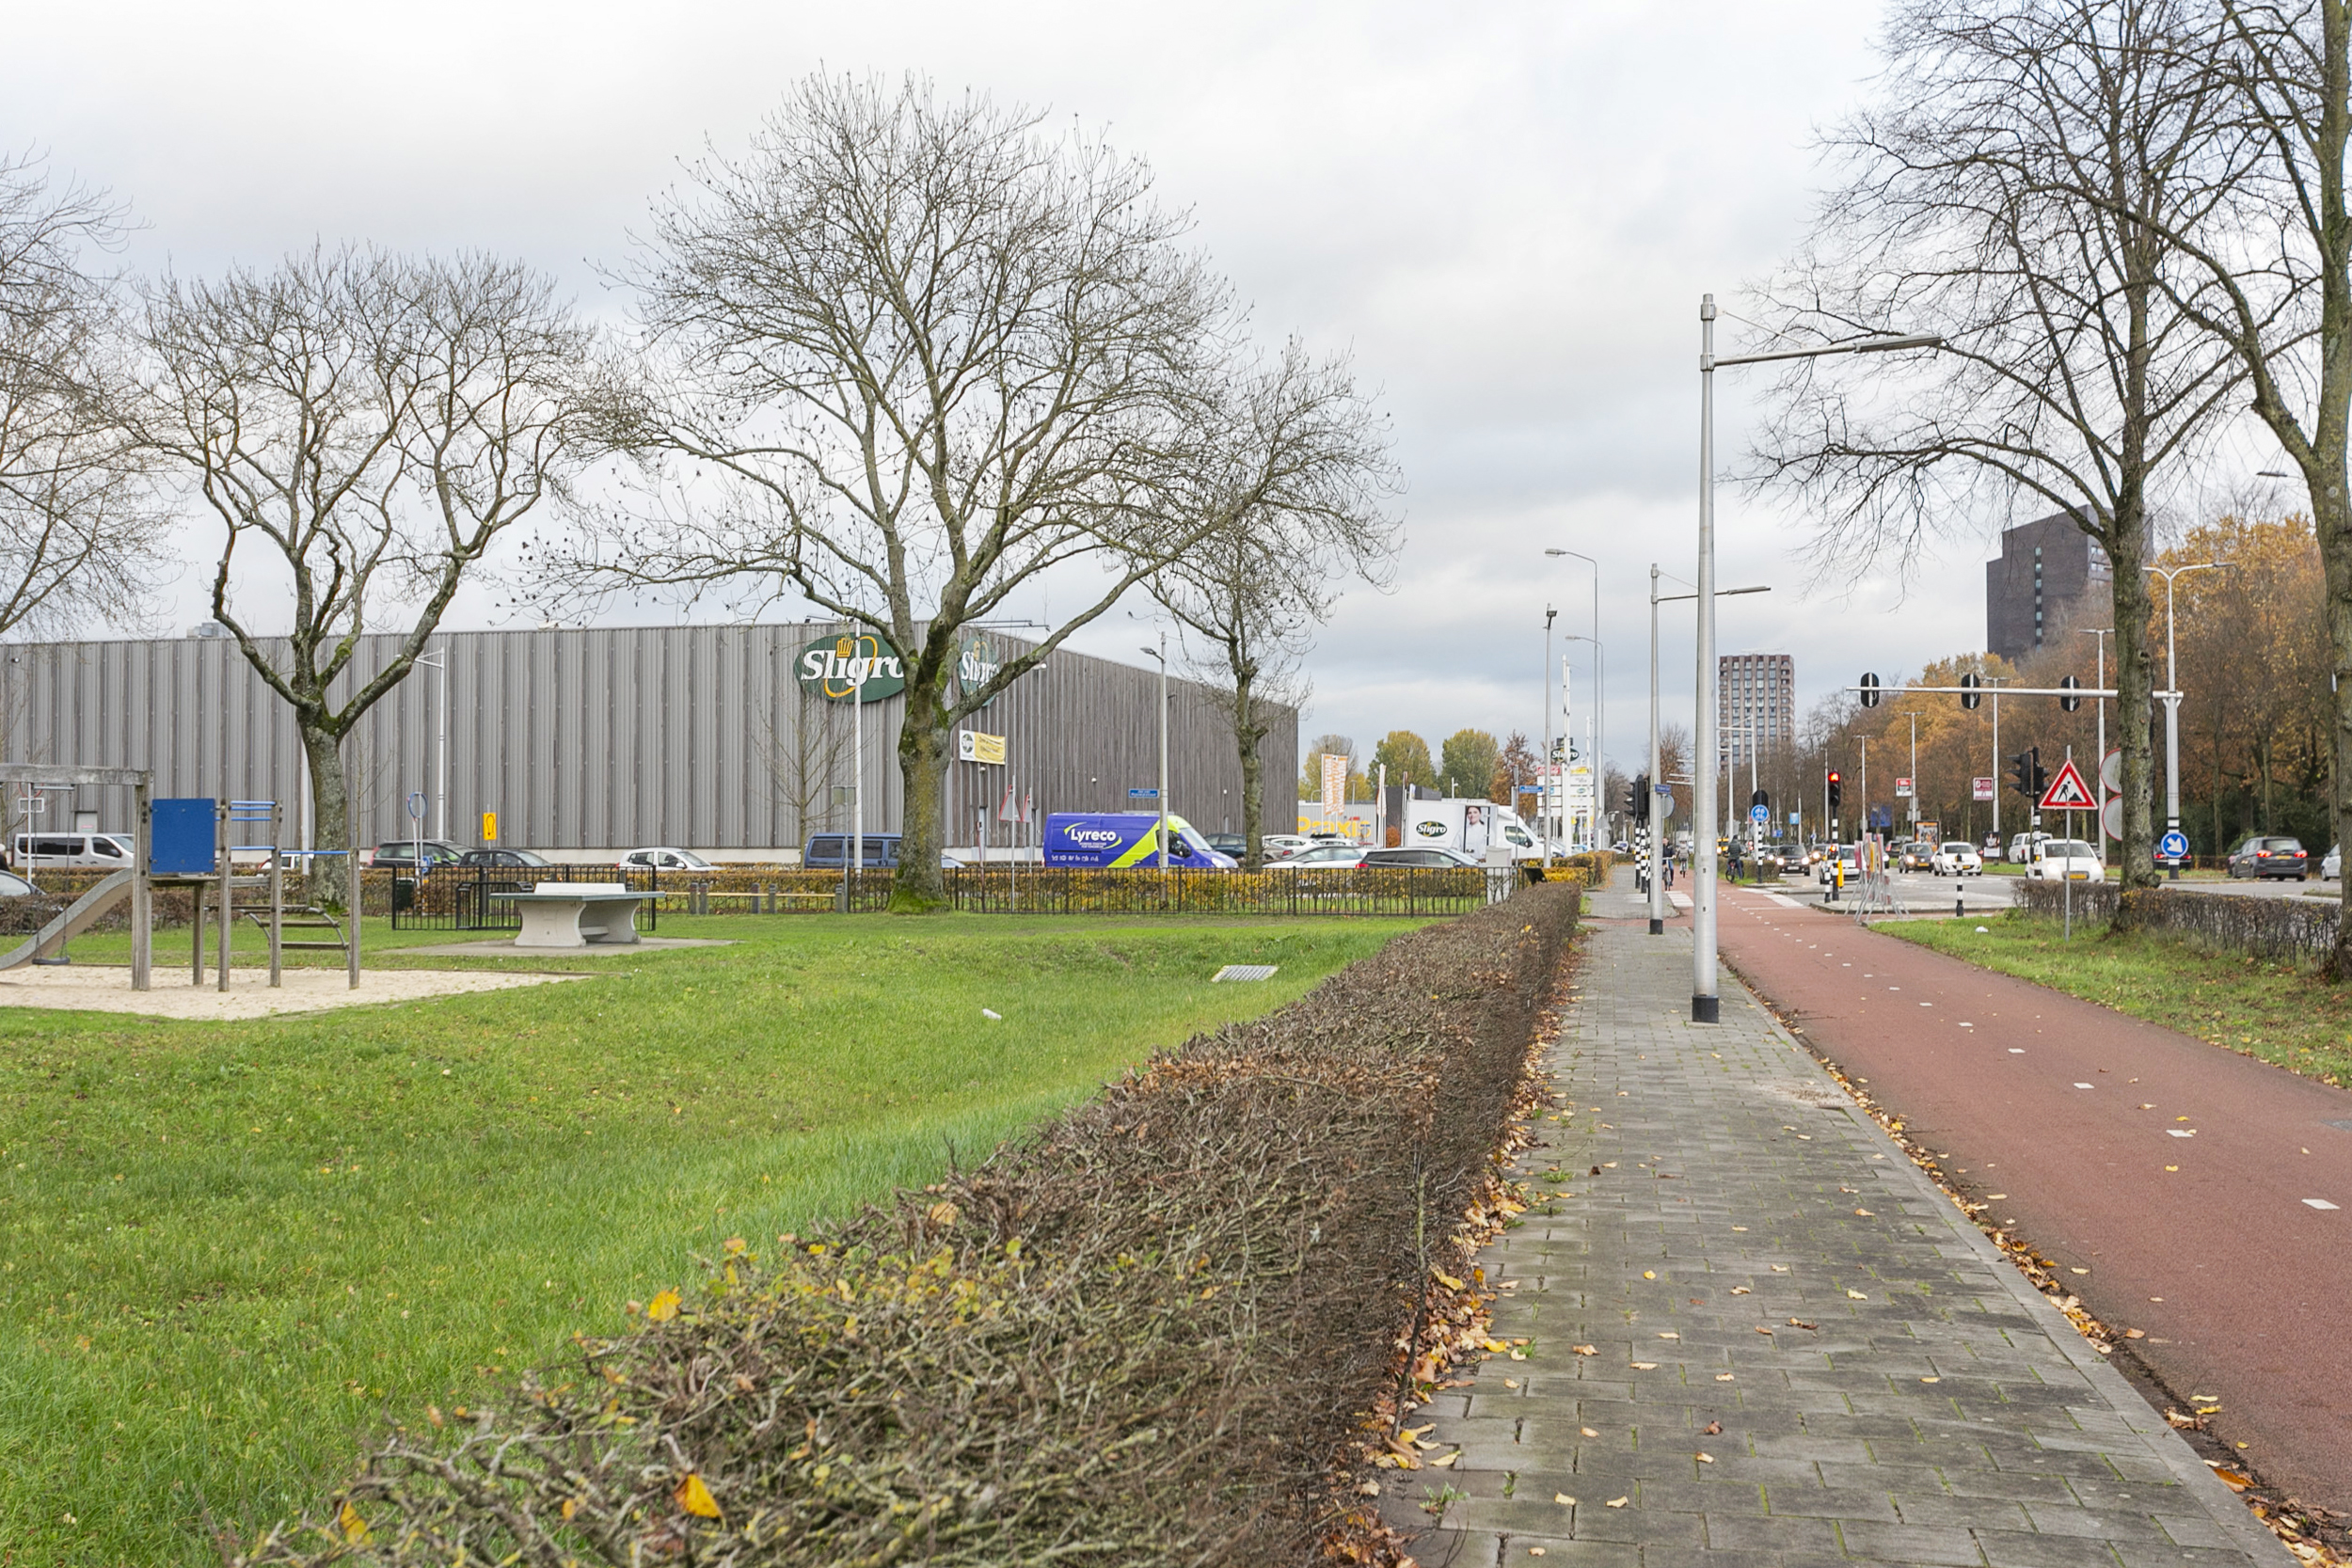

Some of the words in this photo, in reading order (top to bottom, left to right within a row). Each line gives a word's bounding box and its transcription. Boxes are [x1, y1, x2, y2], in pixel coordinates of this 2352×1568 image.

[1297, 816, 1372, 838] Praxis
[1418, 824, 1447, 834] Sligro
[1071, 828, 1117, 843] Lyreco
